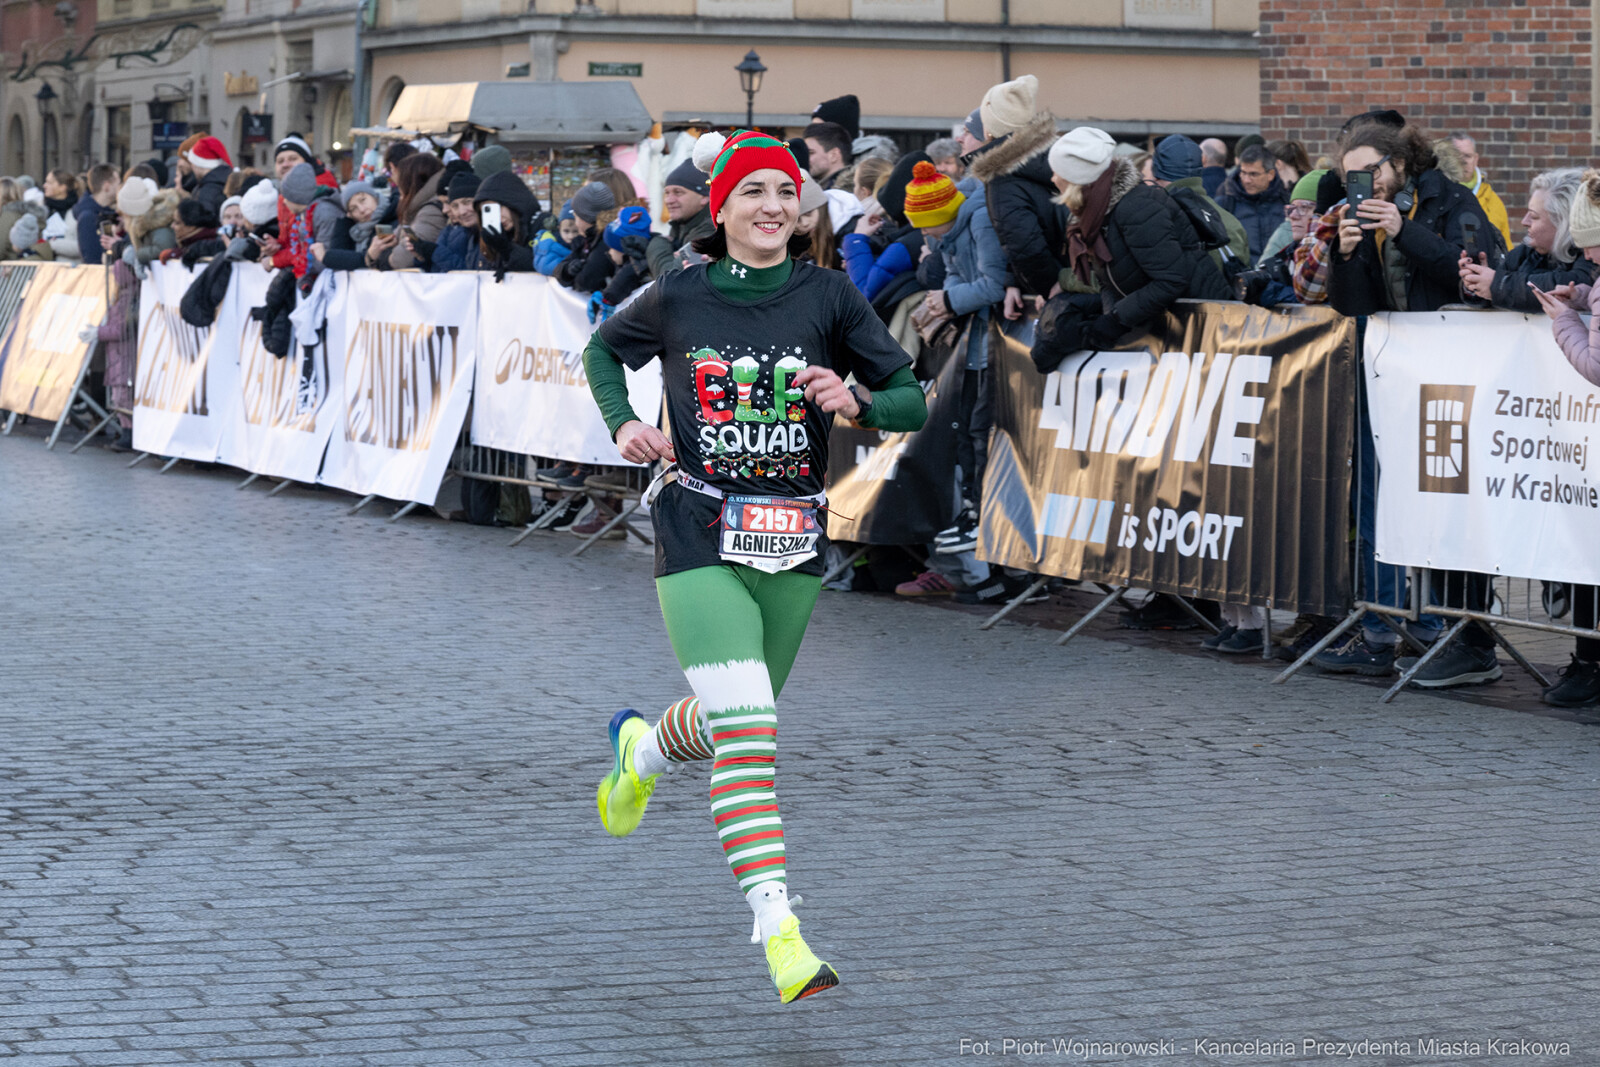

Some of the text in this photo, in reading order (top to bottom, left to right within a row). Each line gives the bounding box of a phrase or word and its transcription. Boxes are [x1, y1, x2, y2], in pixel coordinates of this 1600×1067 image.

[692, 352, 808, 424] ELF
[1495, 389, 1562, 427] Zarząd
[699, 423, 809, 454] SQUAD
[1490, 430, 1588, 471] Sportowej
[1486, 473, 1598, 508] w Krakowie
[749, 507, 798, 531] 2157
[1117, 503, 1244, 561] is SPORT
[732, 533, 810, 554] AGNIESZKA
